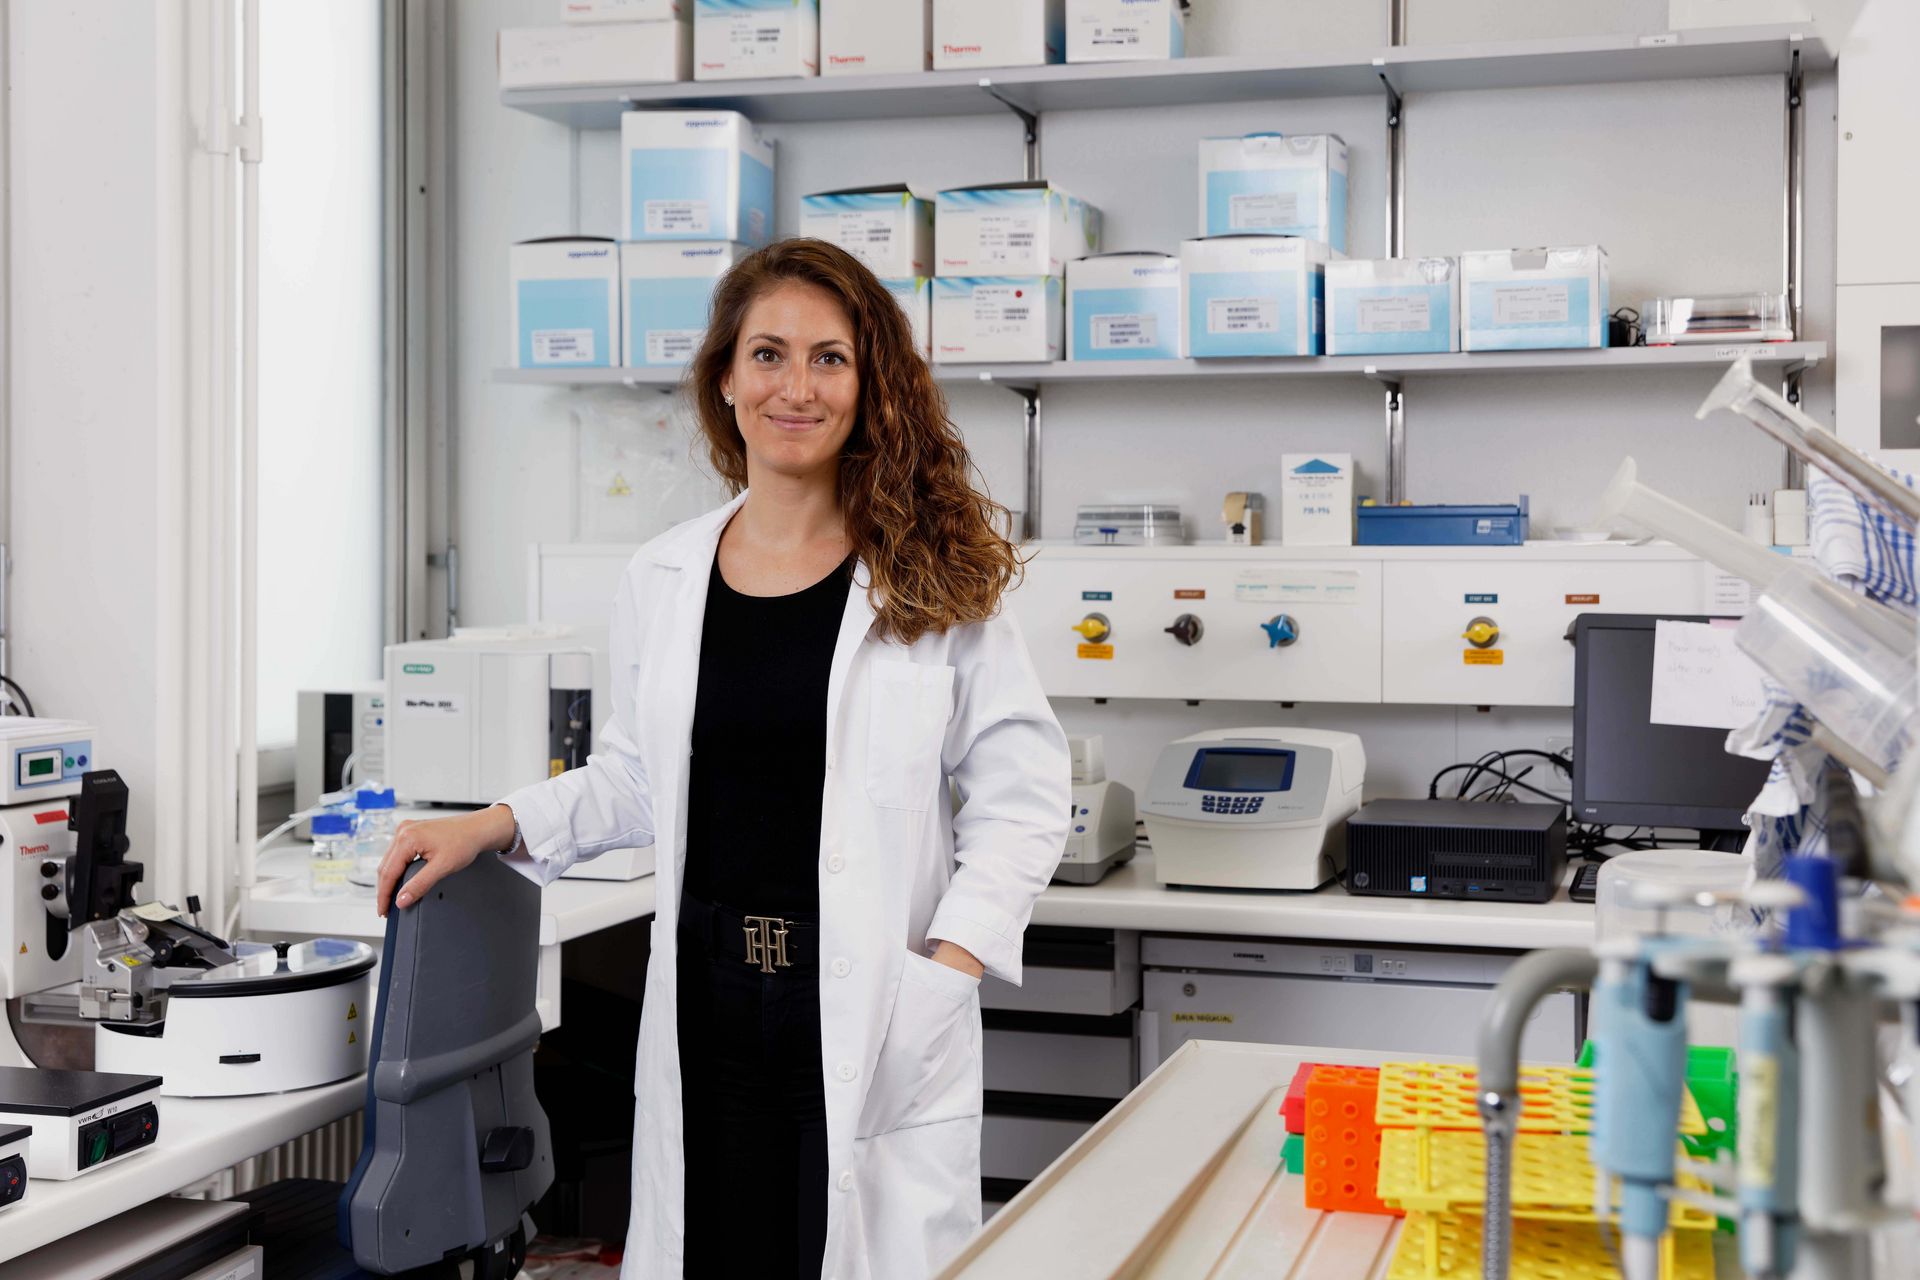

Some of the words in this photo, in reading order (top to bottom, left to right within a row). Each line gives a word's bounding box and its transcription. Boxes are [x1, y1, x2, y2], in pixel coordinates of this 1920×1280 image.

[943, 45, 982, 55] Thermo
[829, 55, 865, 64] Thermo
[20, 844, 49, 856] Thermo
[78, 1115, 92, 1124] VWR
